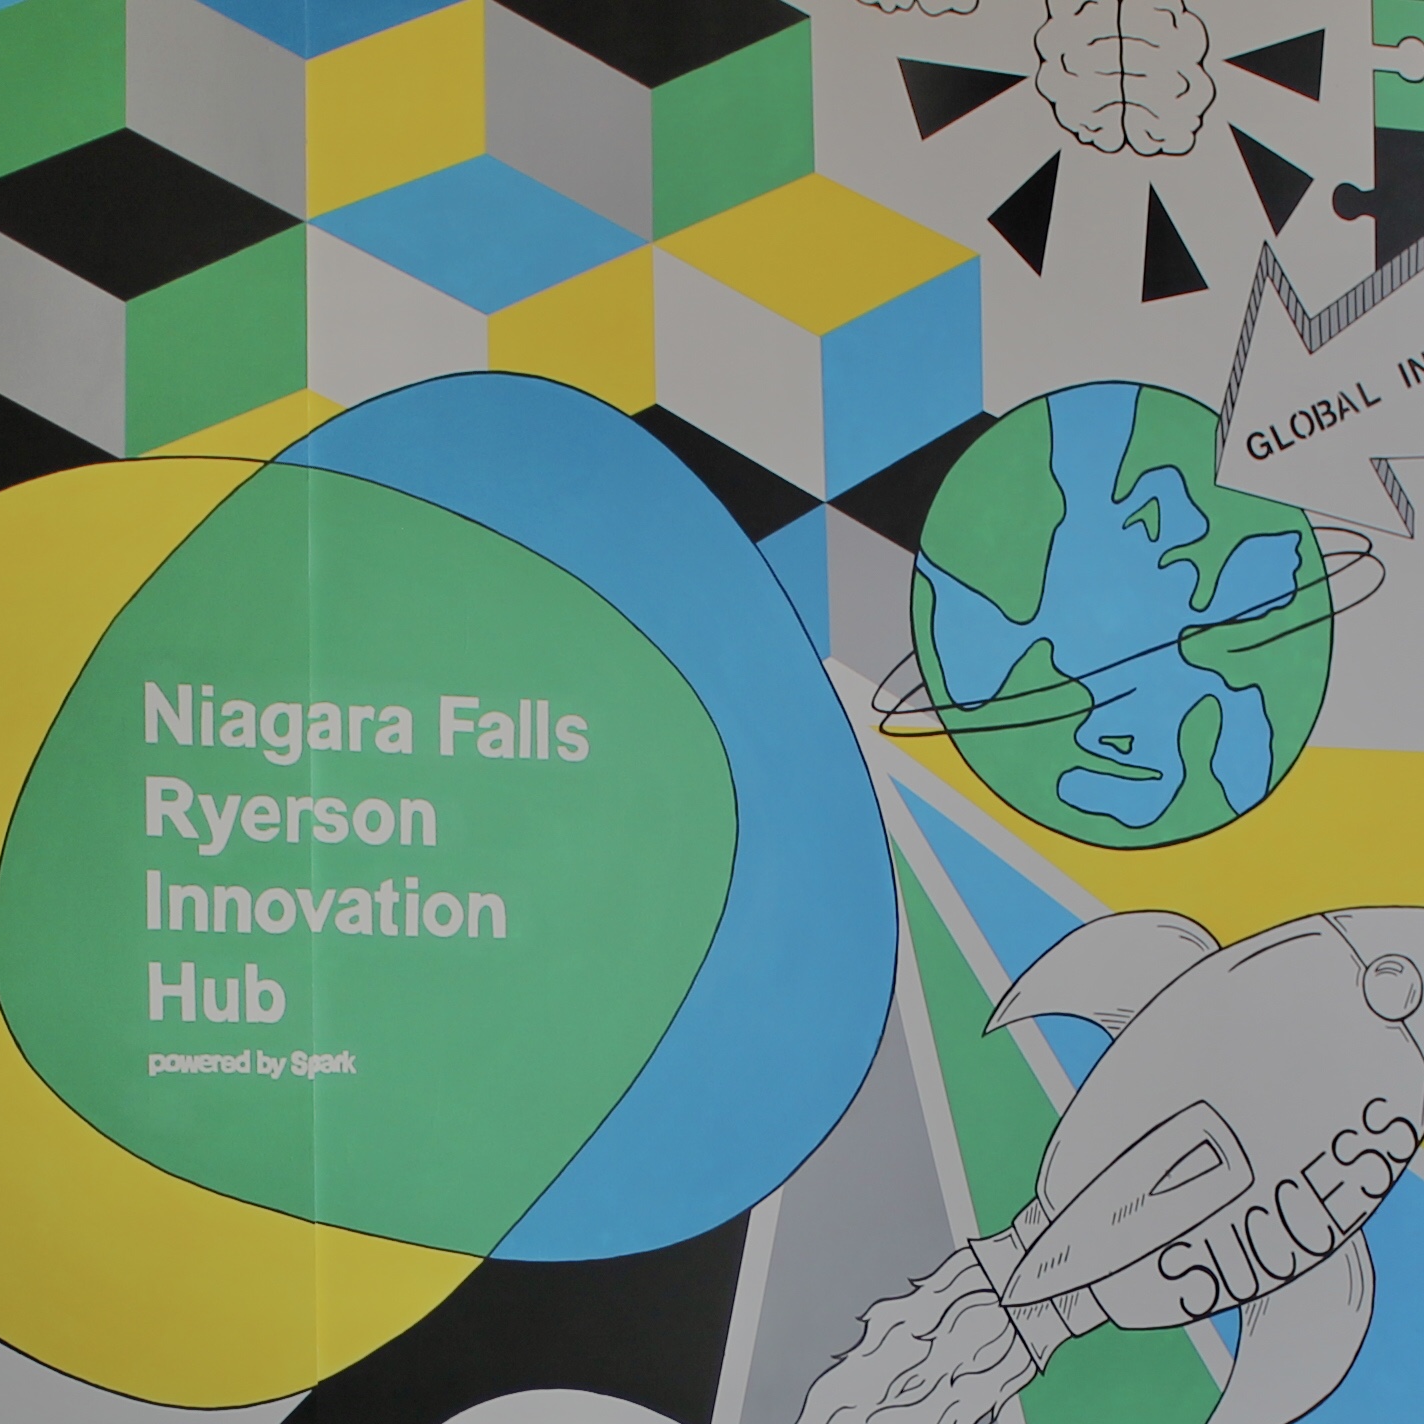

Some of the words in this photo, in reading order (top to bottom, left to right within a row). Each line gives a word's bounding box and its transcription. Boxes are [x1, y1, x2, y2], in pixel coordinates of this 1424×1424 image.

[1246, 382, 1382, 461] GLOBAL
[143, 680, 415, 766] Niagara
[439, 694, 591, 763] Falls
[144, 775, 437, 856] Ryerson
[146, 869, 508, 939] Innovation
[148, 961, 287, 1024] Hub
[148, 1049, 251, 1077] powered
[256, 1050, 287, 1080] by
[290, 1050, 357, 1080] Spark
[1158, 1096, 1419, 1319] SUCCESS
